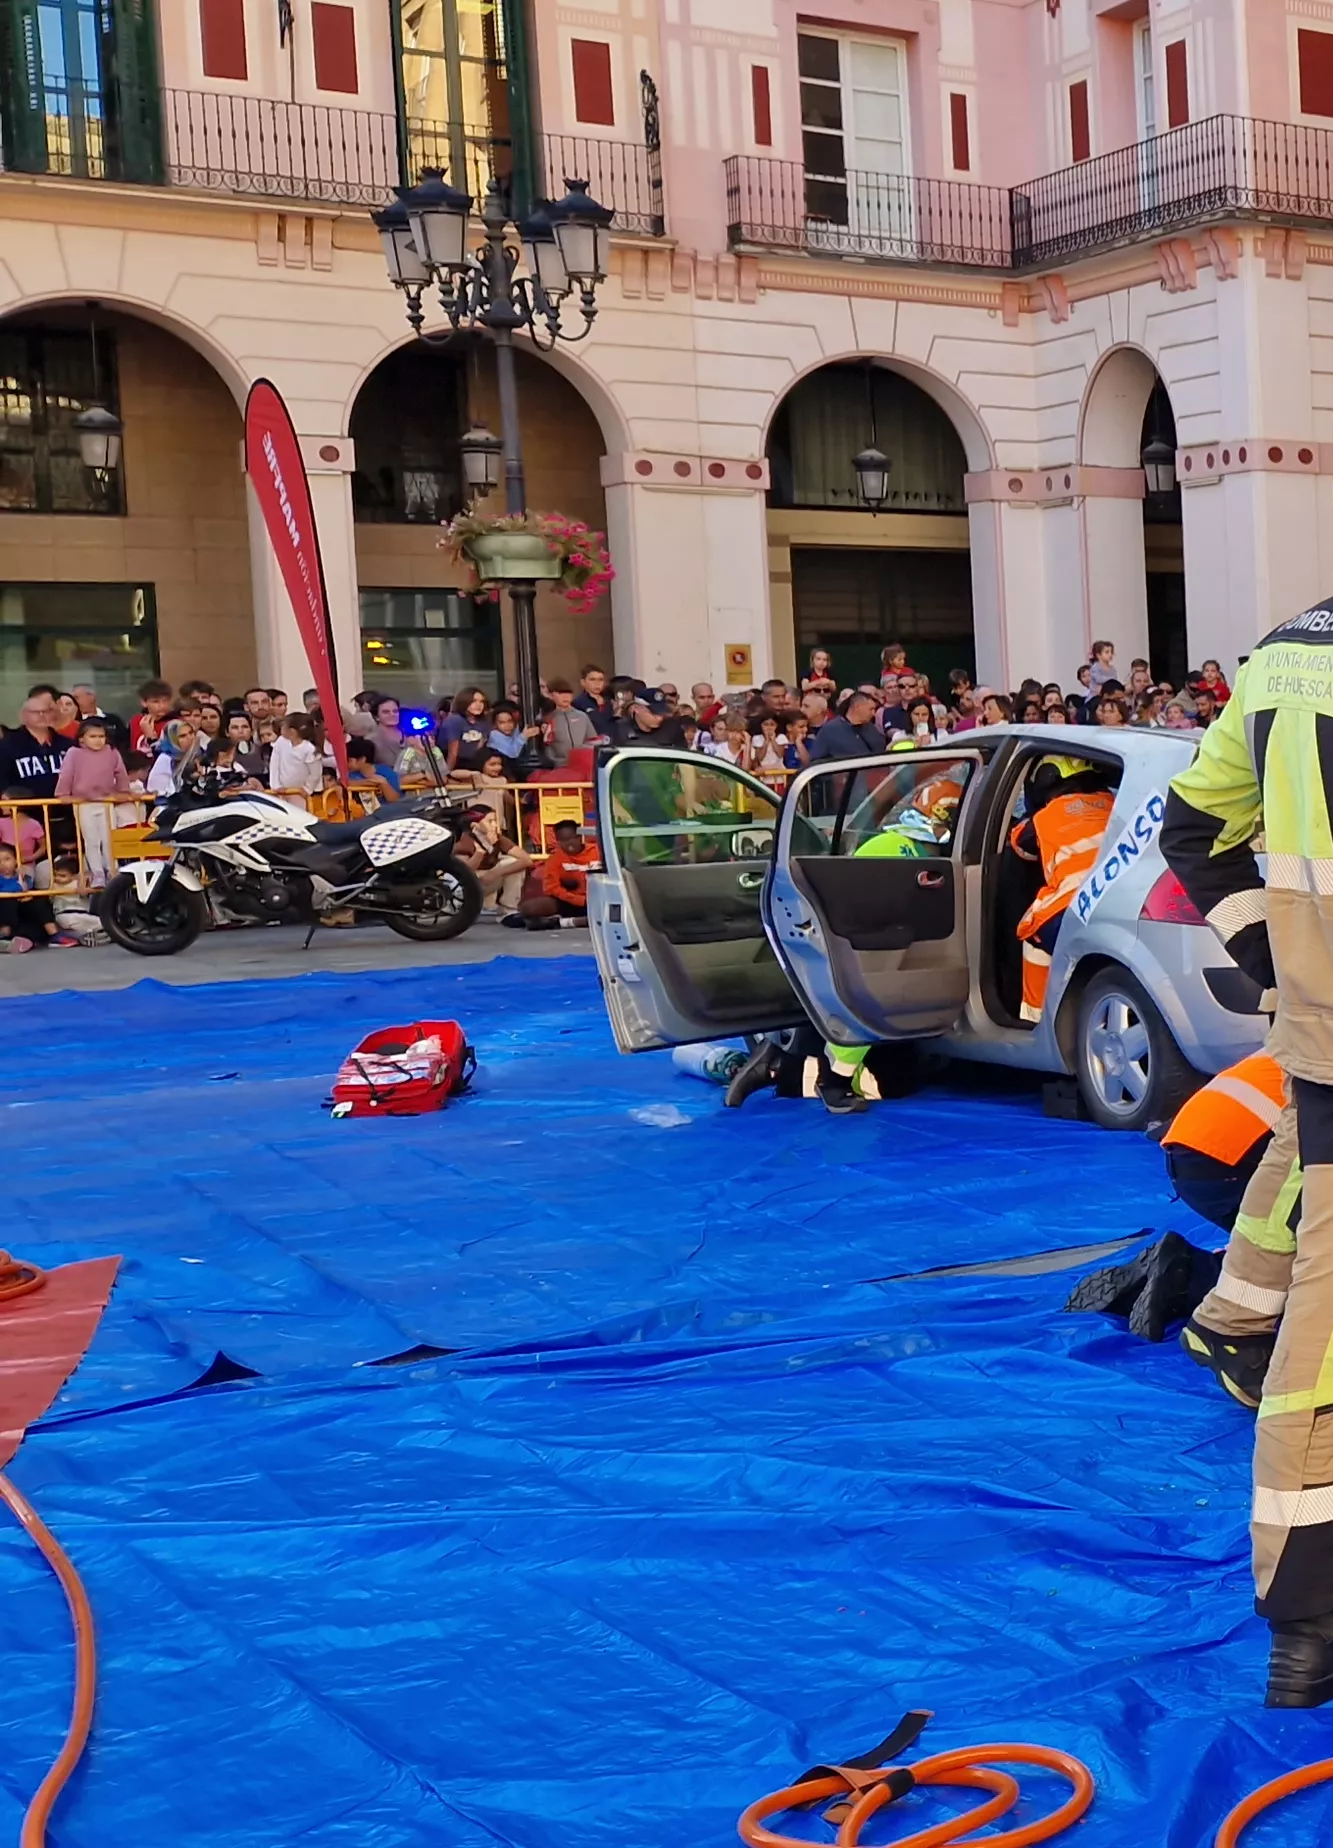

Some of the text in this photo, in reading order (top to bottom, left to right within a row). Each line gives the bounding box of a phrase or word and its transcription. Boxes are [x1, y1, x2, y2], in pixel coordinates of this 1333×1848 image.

[1267, 675, 1333, 699] DE HUESCA
[1077, 795, 1166, 922] ALONSO
